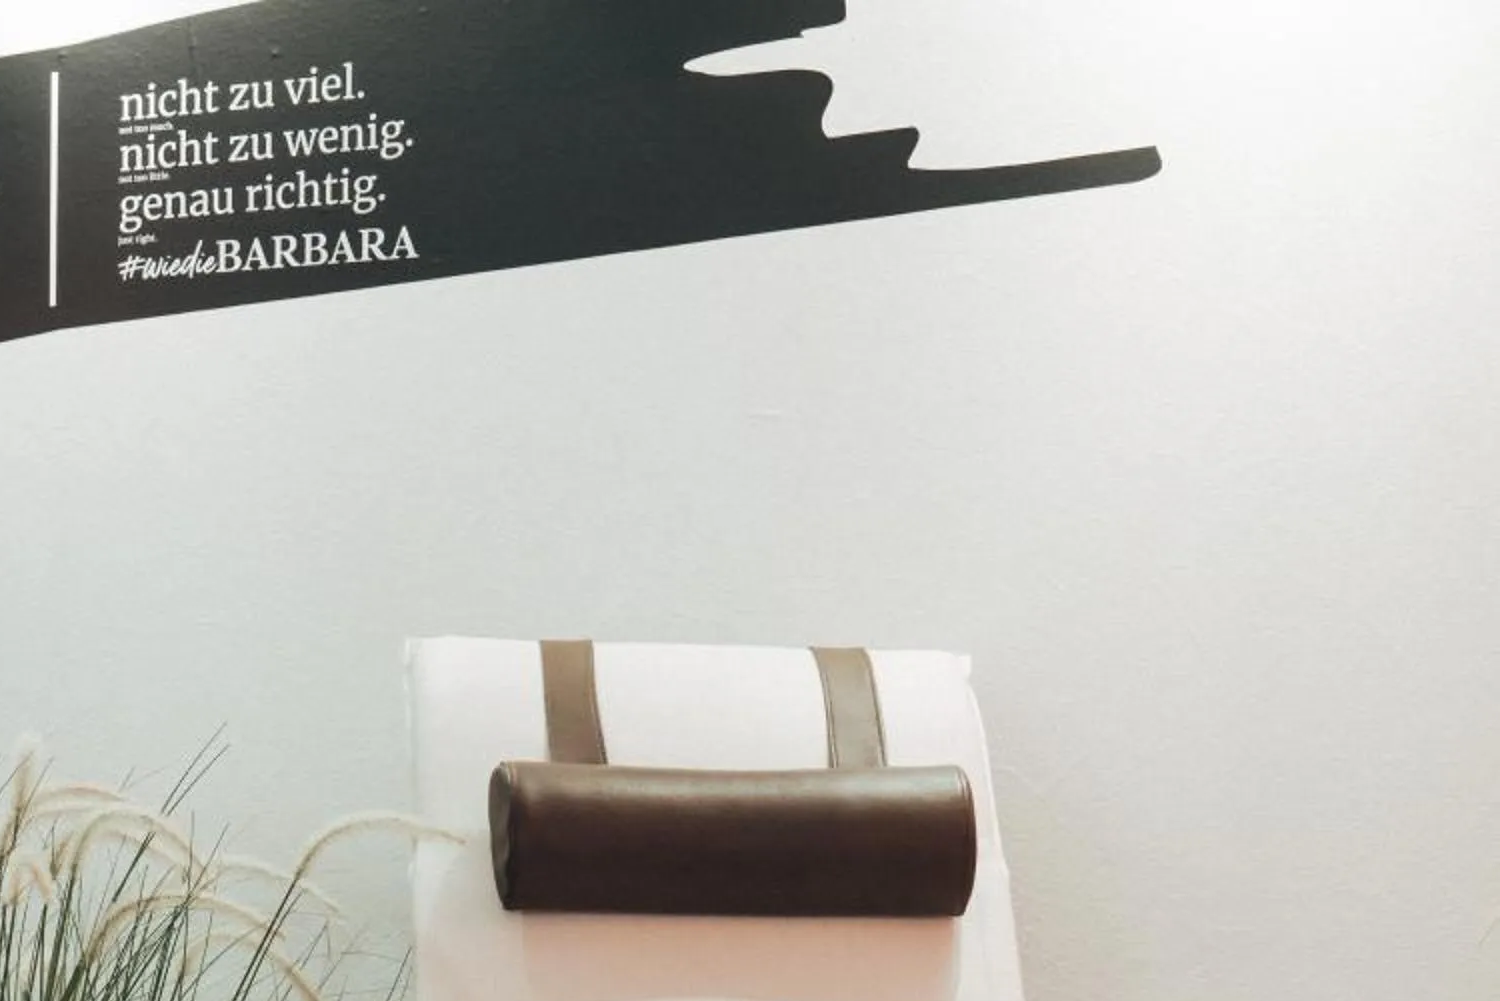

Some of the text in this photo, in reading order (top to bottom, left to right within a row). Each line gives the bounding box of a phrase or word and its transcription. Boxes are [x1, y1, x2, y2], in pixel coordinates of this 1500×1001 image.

[119, 61, 365, 122] nicht zu viel.
[119, 113, 414, 172] nicht zu wenig.
[118, 168, 387, 234] genau richtig.
